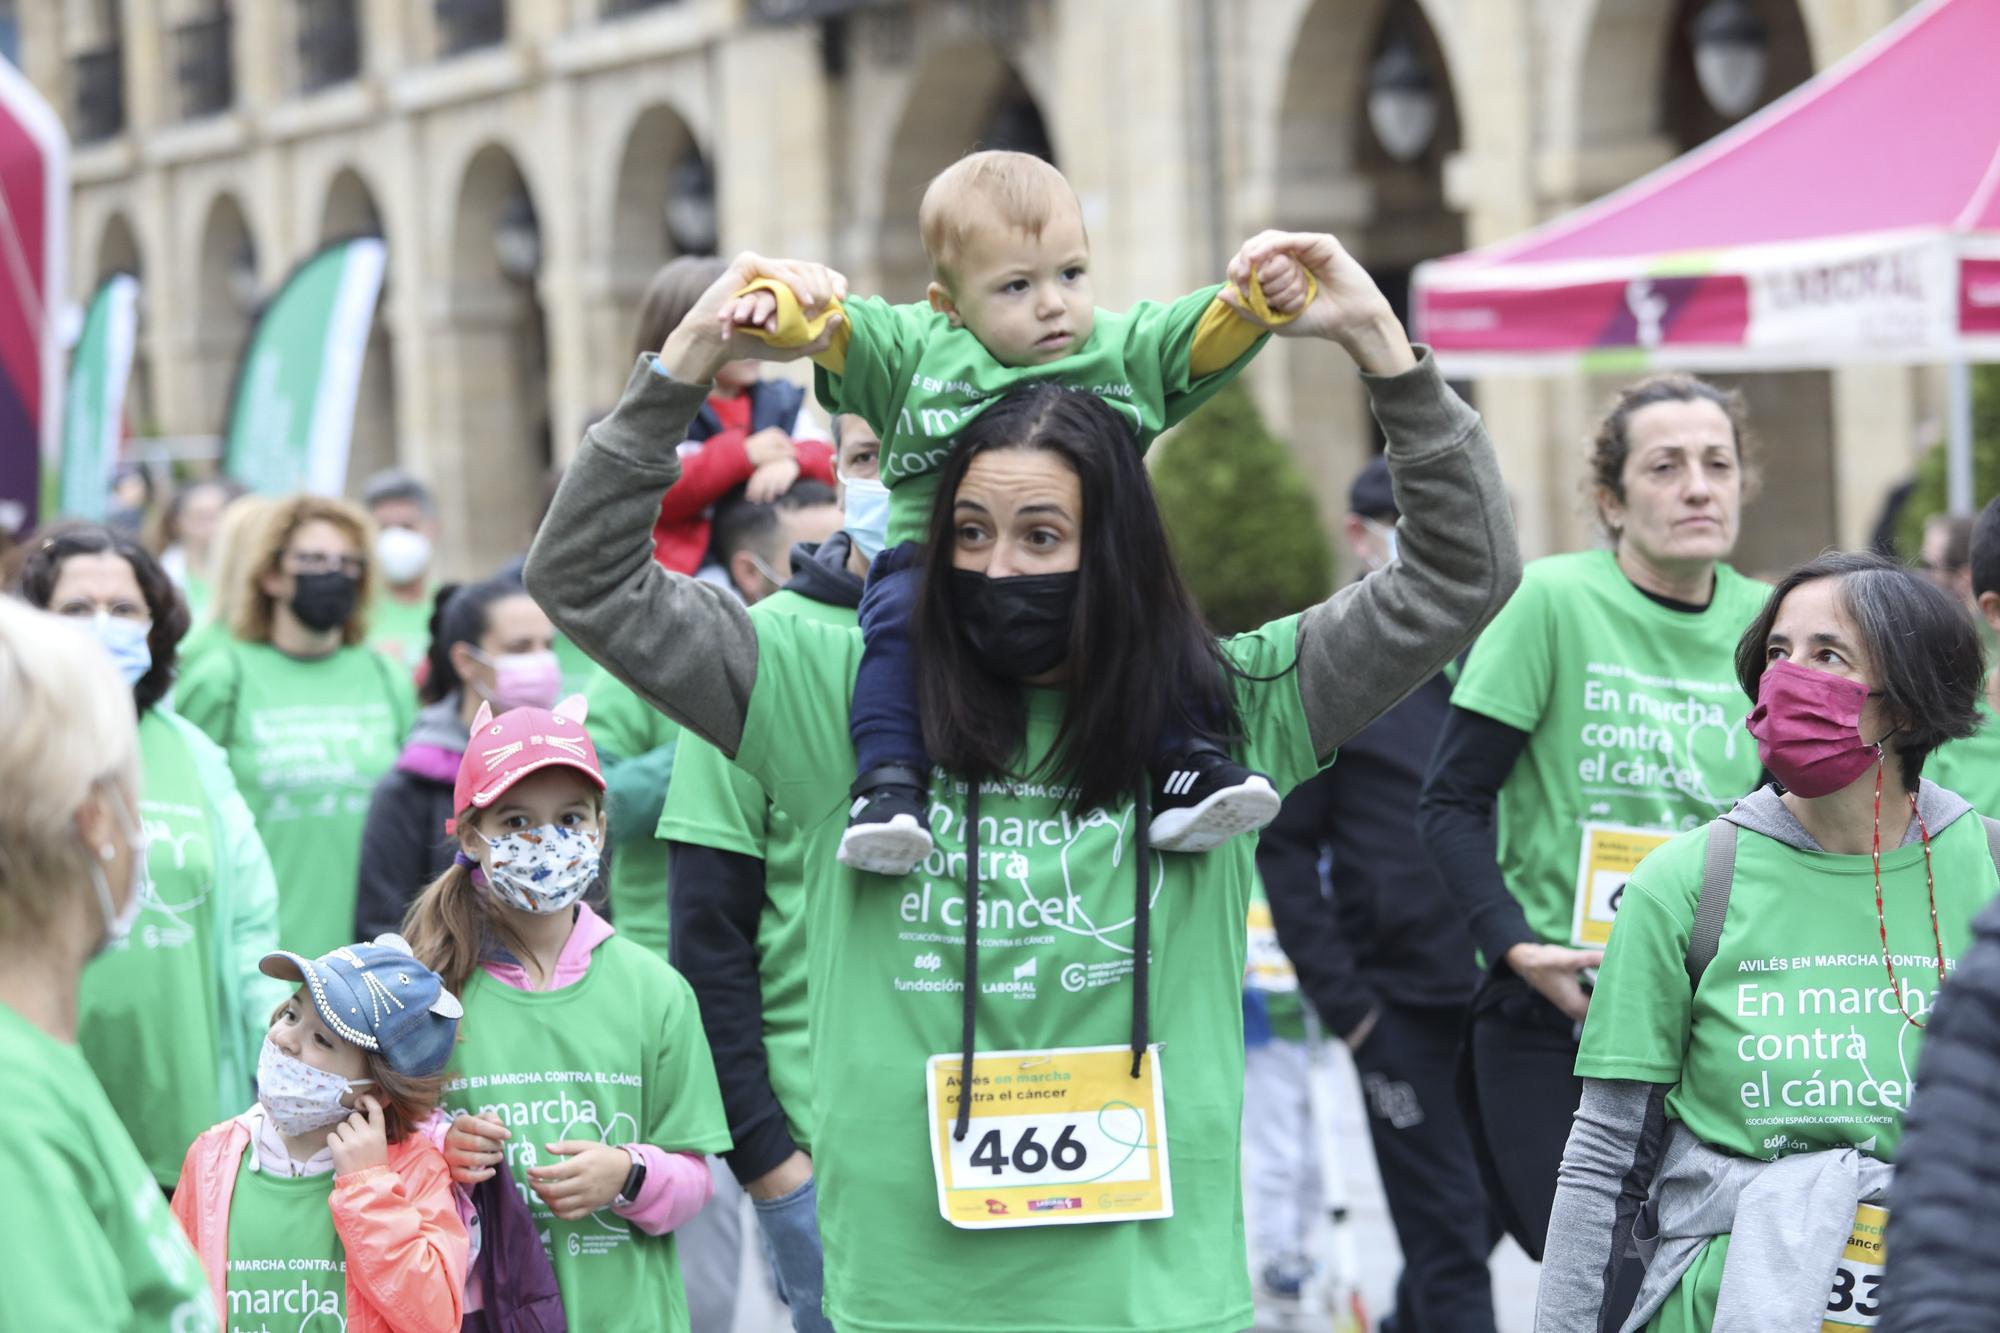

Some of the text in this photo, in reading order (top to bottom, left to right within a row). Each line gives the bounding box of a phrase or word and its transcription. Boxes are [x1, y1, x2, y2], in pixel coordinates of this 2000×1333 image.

[922, 377, 943, 393] EN
[1584, 681, 1620, 712] En
[1581, 721, 1674, 754] contra
[1579, 752, 1606, 783] el
[900, 882, 931, 923] el
[1738, 955, 1789, 972] AVILÉS
[1792, 955, 1811, 971] EN
[1815, 954, 1879, 967] MARCHA
[1882, 954, 1939, 969] CONTRA
[894, 976, 1037, 994] fundación LABORAL
[1737, 983, 1784, 1017] En
[1738, 1027, 1867, 1062] contra
[471, 1075, 487, 1088] EN
[490, 1071, 542, 1086] MARCHA
[545, 1070, 593, 1083] CONTRA
[595, 1071, 608, 1084] EL
[994, 1074, 1012, 1085] en
[1016, 1070, 1072, 1084] marcha
[1740, 1069, 1916, 1108] el cáncer
[999, 1088, 1012, 1101] el
[1016, 1087, 1068, 1100] cáncer
[1785, 1114, 1823, 1124] ESPAÑOLA
[1824, 1115, 1855, 1124] CONTRA
[1856, 1116, 1864, 1124] EL
[1864, 1115, 1893, 1124] CÁNCER
[969, 1125, 1087, 1175] 466
[235, 1259, 286, 1271] MARCHA
[288, 1259, 338, 1272] CONTRA
[227, 1279, 339, 1315] marcha
